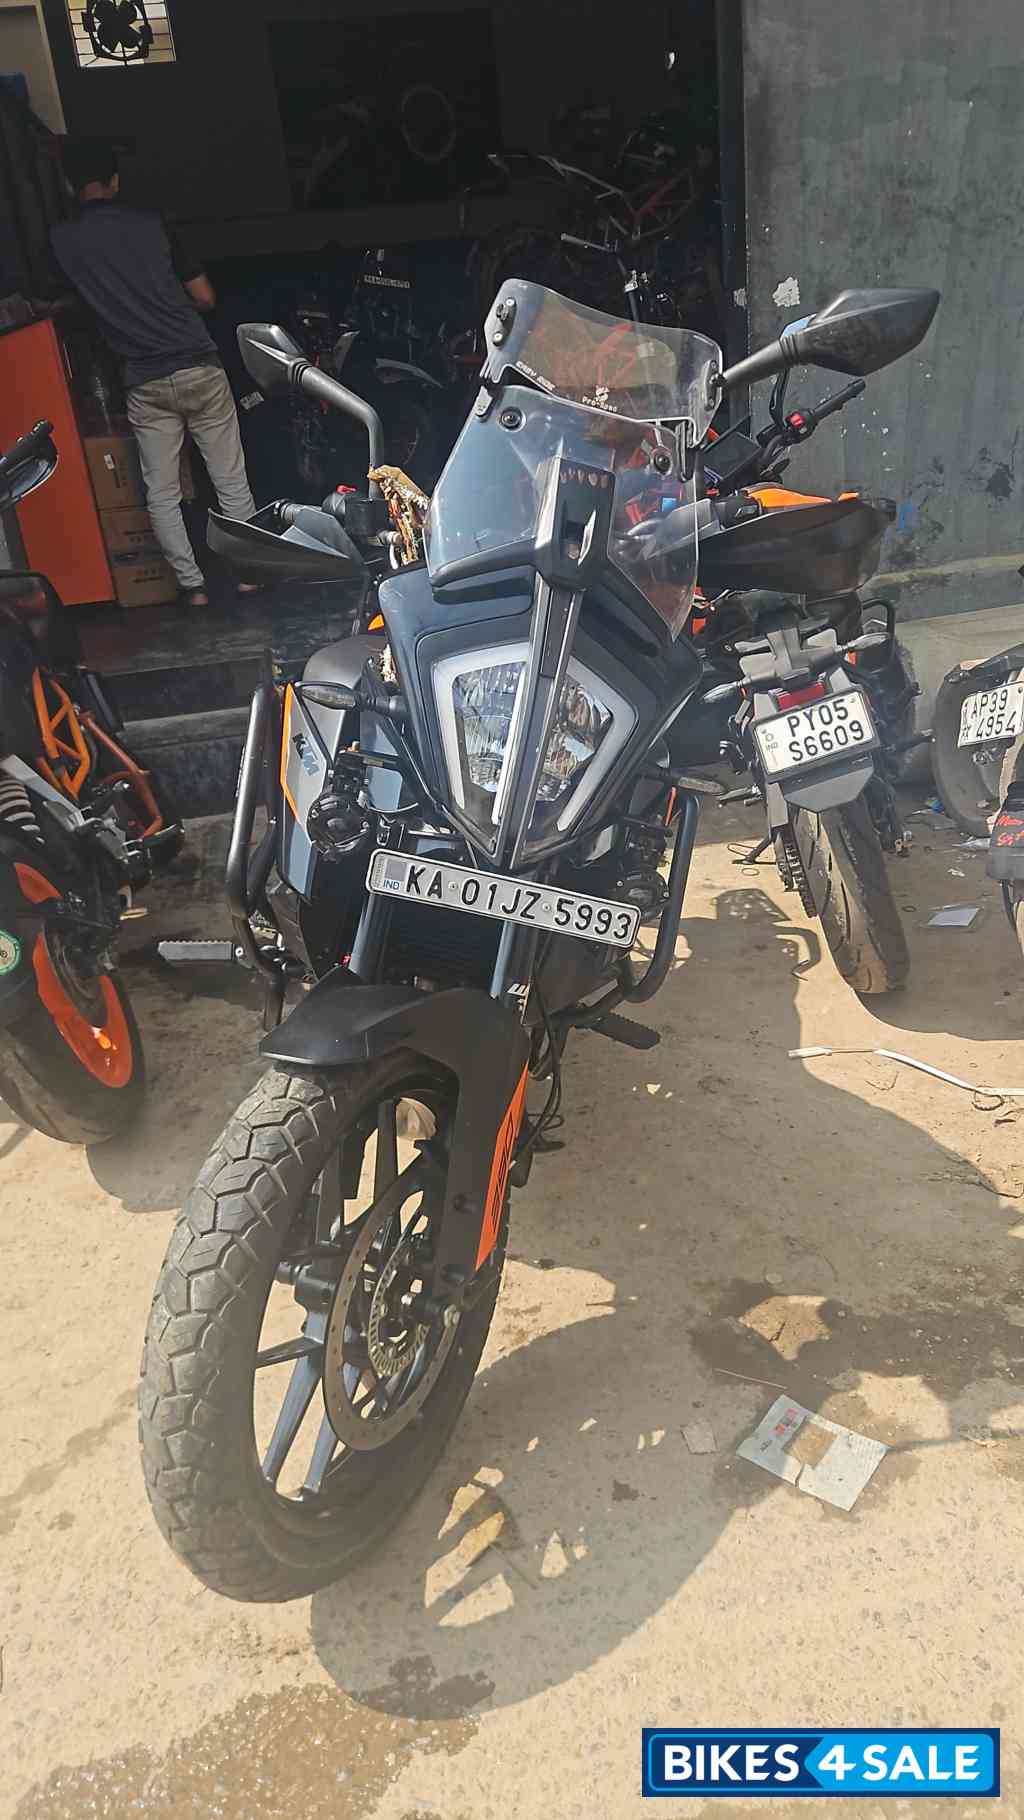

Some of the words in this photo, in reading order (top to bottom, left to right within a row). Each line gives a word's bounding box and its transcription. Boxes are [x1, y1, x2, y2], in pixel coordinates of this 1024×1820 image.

[787, 699, 848, 737] PY05
[971, 689, 1008, 719] AP39
[788, 720, 864, 761] S6609
[976, 711, 1017, 738] 4954
[292, 733, 320, 776] KTM
[383, 879, 401, 890] IND
[406, 865, 443, 899] KA
[554, 898, 632, 939] 5993
